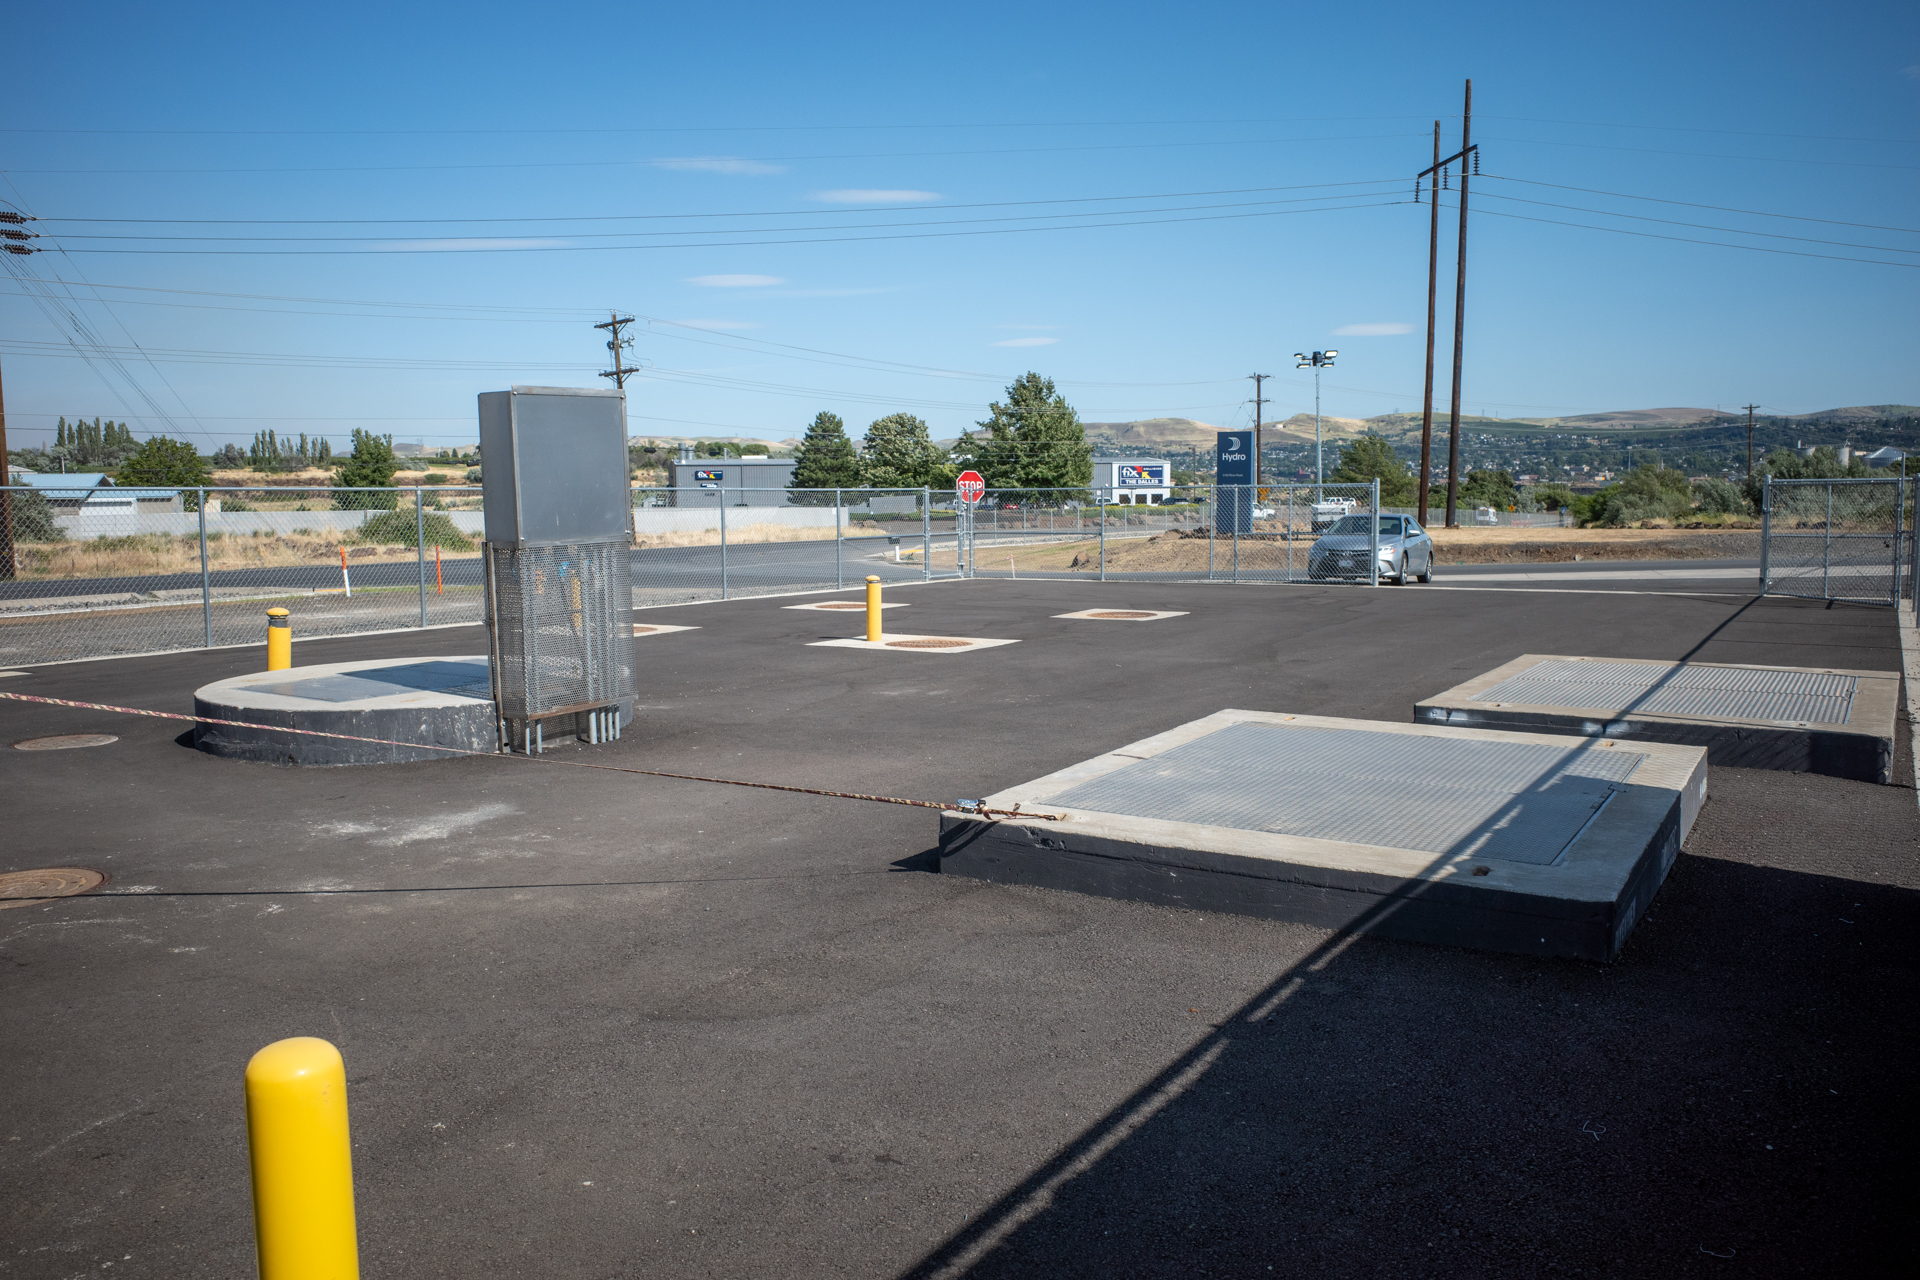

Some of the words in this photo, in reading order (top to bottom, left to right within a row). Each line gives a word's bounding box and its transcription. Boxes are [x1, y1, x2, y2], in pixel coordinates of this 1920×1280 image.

[1222, 453, 1246, 462] Hydro
[1121, 467, 1139, 478] fix
[958, 480, 983, 493] STOP
